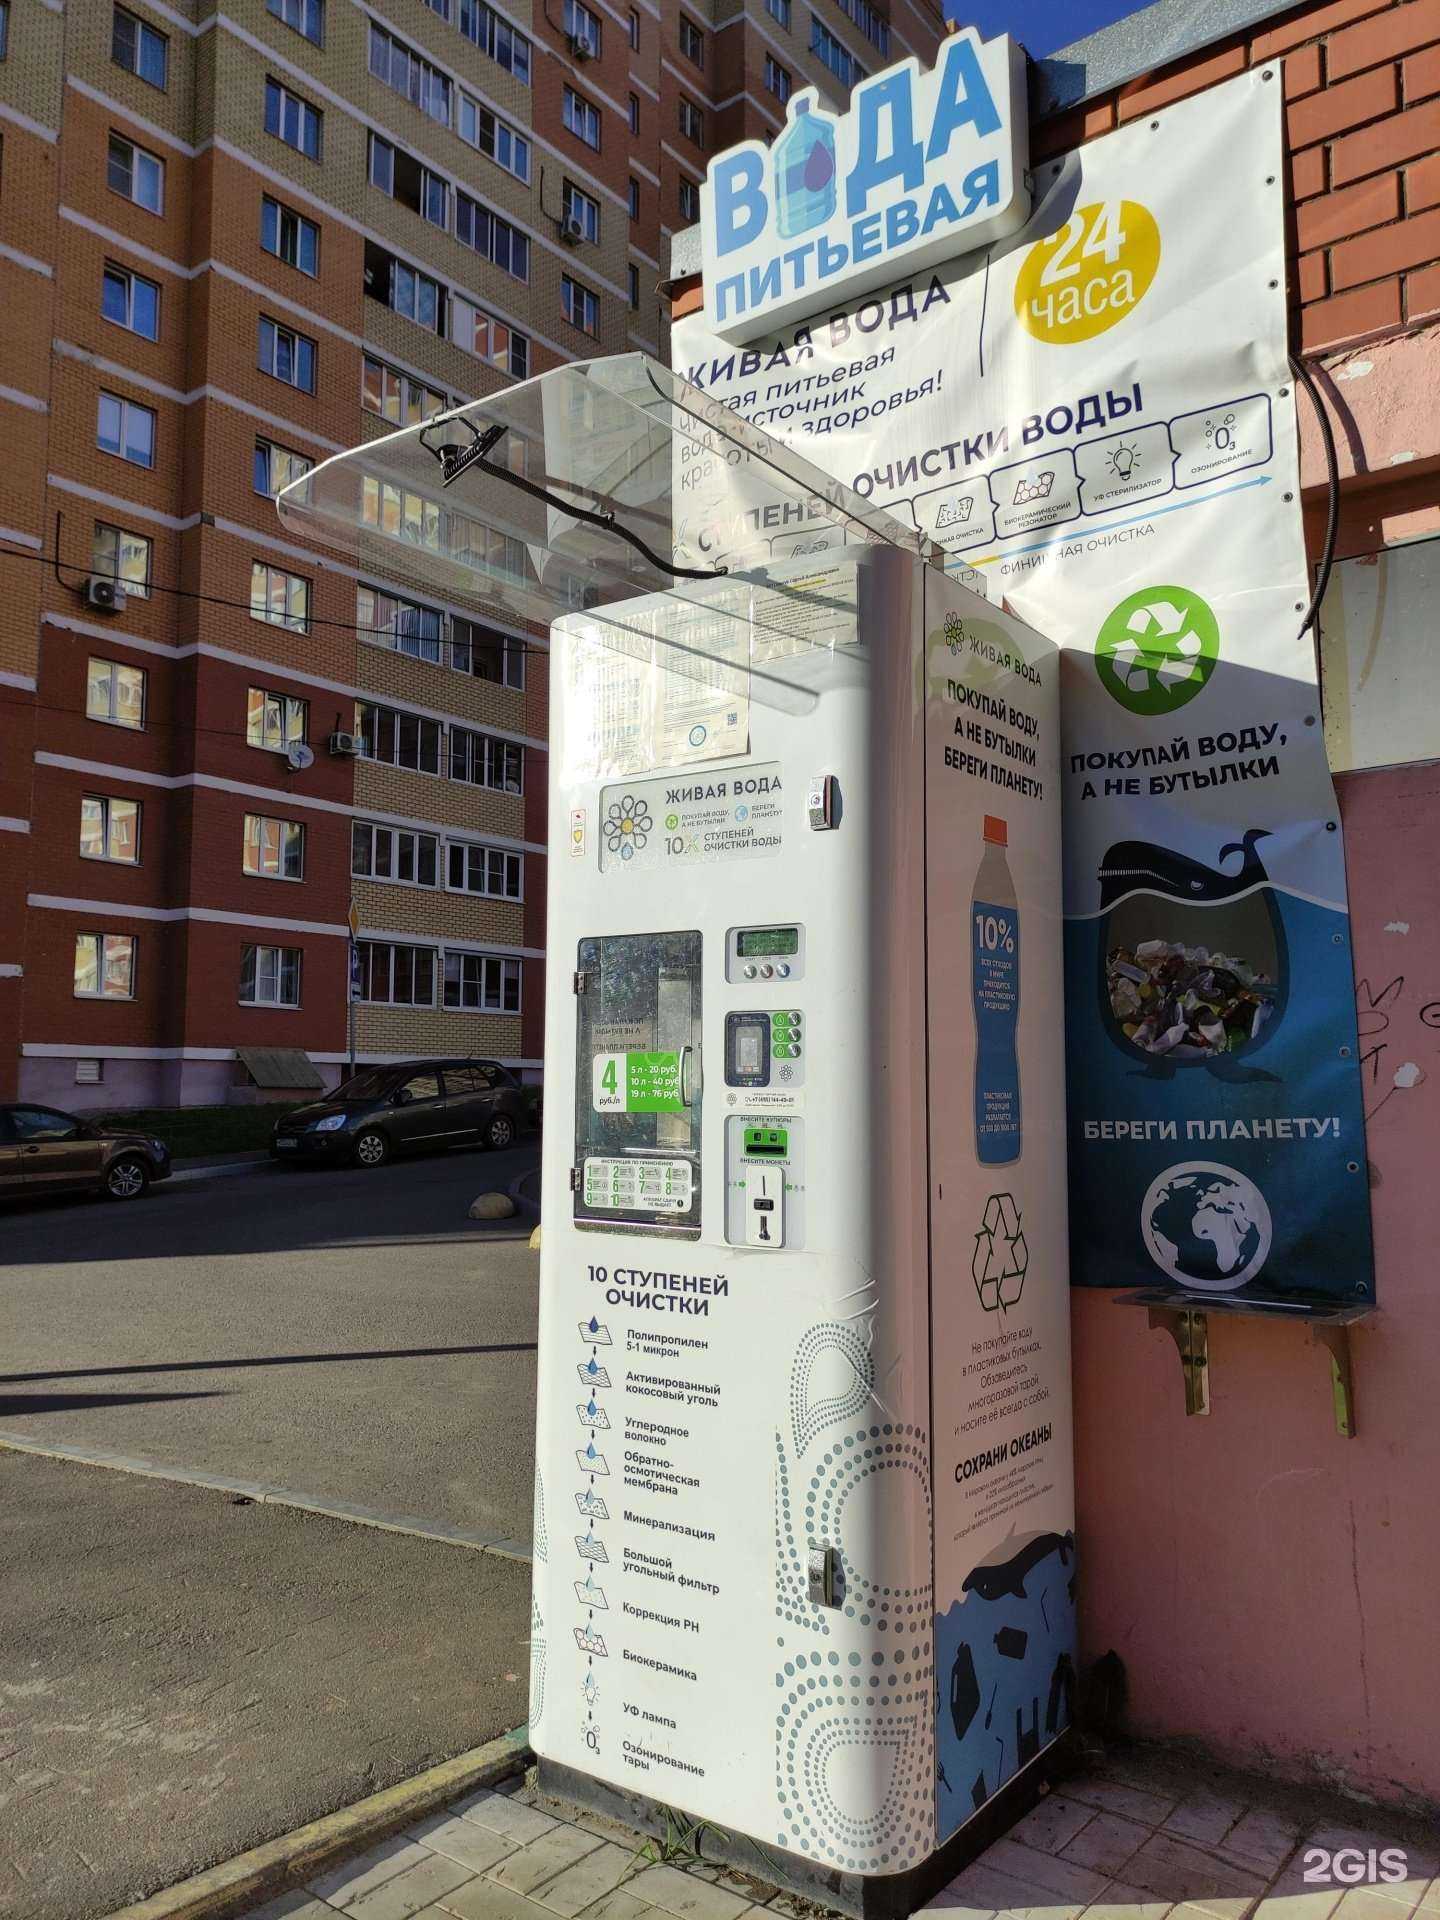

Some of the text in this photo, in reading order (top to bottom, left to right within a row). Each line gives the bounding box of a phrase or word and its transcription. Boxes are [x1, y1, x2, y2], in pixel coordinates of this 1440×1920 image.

[715, 159, 1000, 322] ПИТЬЕВАЯ
[1040, 199, 1126, 287] 24
[829, 274, 951, 348] ВОДА
[1031, 269, 1136, 328] часа
[766, 346, 896, 401] питьевая
[853, 426, 1010, 499] ОЧИСТКИ
[1022, 382, 1143, 446] ВОДЫ
[1106, 478, 1162, 498] СТЕРИЛИЗАТОР
[1000, 543, 1083, 576] ФИНИНАЯ
[1086, 523, 1156, 551] ОЧИСТКА
[969, 634, 1043, 688] ЖИВАЯ ВОДА
[948, 678, 1041, 741] ПОКУПАЙ ВОДУ,
[954, 716, 1036, 768] А НЕ БУТЫЛКИ
[1071, 722, 1288, 774] ПОКУПАЙ ВОДУ,
[944, 746, 1043, 801] БЕРЕГИ ПЛАНЕТУ!
[1081, 756, 1280, 801] А НЕ БУТЫЛКИ
[666, 776, 782, 804] ЖИВАЯ ВОДА
[665, 836, 684, 855] 10
[704, 826, 754, 841] СТУПЕНЕЙ
[704, 836, 782, 852] ОЧИСТКИ ВОДЫ
[976, 914, 1014, 953] 10%
[601, 1060, 617, 1095] 4
[631, 1066, 636, 1074] 5
[649, 1066, 658, 1074] 20
[653, 1078, 663, 1086] 40
[631, 1089, 639, 1098] 19
[652, 1090, 662, 1098] 76
[1084, 1117, 1342, 1141] БЕРЕГИ ПЛАНЕТУ!
[587, 1165, 592, 1177] 1
[613, 1165, 619, 1179] 2
[639, 1166, 645, 1180] 3
[665, 1167, 673, 1181] 4
[586, 1192, 620, 1207] 9 10
[587, 1179, 593, 1191] 5
[612, 1180, 619, 1193] 6
[639, 1181, 645, 1194] 7
[665, 1182, 672, 1195] 8
[588, 1265, 729, 1297] 10 СТУПЕНЕЙ
[605, 1288, 709, 1317] ОЧИСТКИ
[626, 1341, 680, 1359] 5-1 микрон
[627, 1329, 708, 1350] Полипропилен
[972, 1341, 981, 1354] Не
[625, 1371, 721, 1396] Активированный
[625, 1384, 719, 1408] кокосовый уголь
[624, 1431, 667, 1447] волокно
[625, 1416, 689, 1438] Углеродное
[624, 1450, 674, 1470] Обратно-
[954, 1443, 1009, 1483] СОХРАНИ
[1010, 1422, 1052, 1457] ОКЕАНЫ
[624, 1465, 700, 1488] осмотическая
[624, 1476, 678, 1496] мембрана
[624, 1510, 716, 1542] Минерализация
[624, 1548, 672, 1569] Большой
[623, 1561, 720, 1595] угольный фильтр
[623, 1601, 681, 1628] Коррекция
[623, 1649, 698, 1682] Биокерамика
[622, 1702, 677, 1730] УФ лампа
[622, 1740, 705, 1777] Озонирование
[622, 1753, 650, 1771] тары
